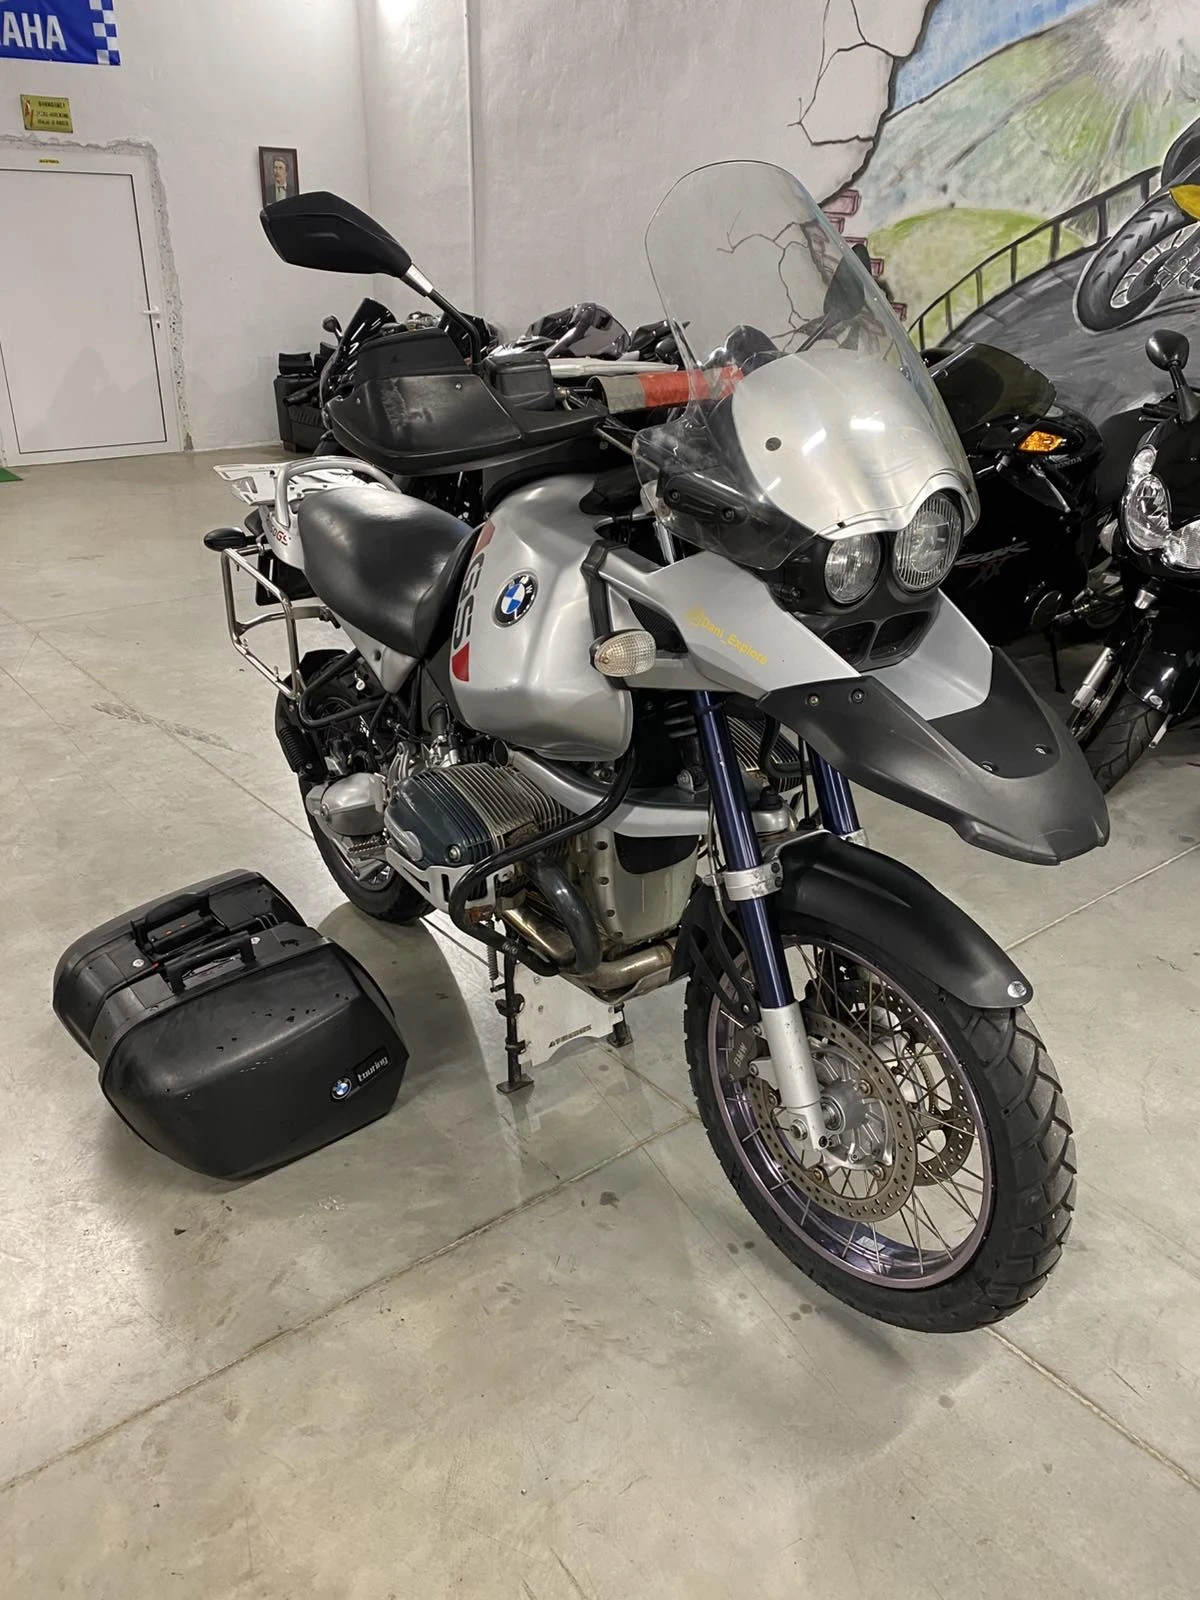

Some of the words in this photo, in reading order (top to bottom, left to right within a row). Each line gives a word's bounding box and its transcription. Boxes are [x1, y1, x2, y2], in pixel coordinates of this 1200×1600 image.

[0, 11, 67, 51] AHA
[733, 1041, 748, 1068] BMW
[357, 1056, 389, 1082] touring
